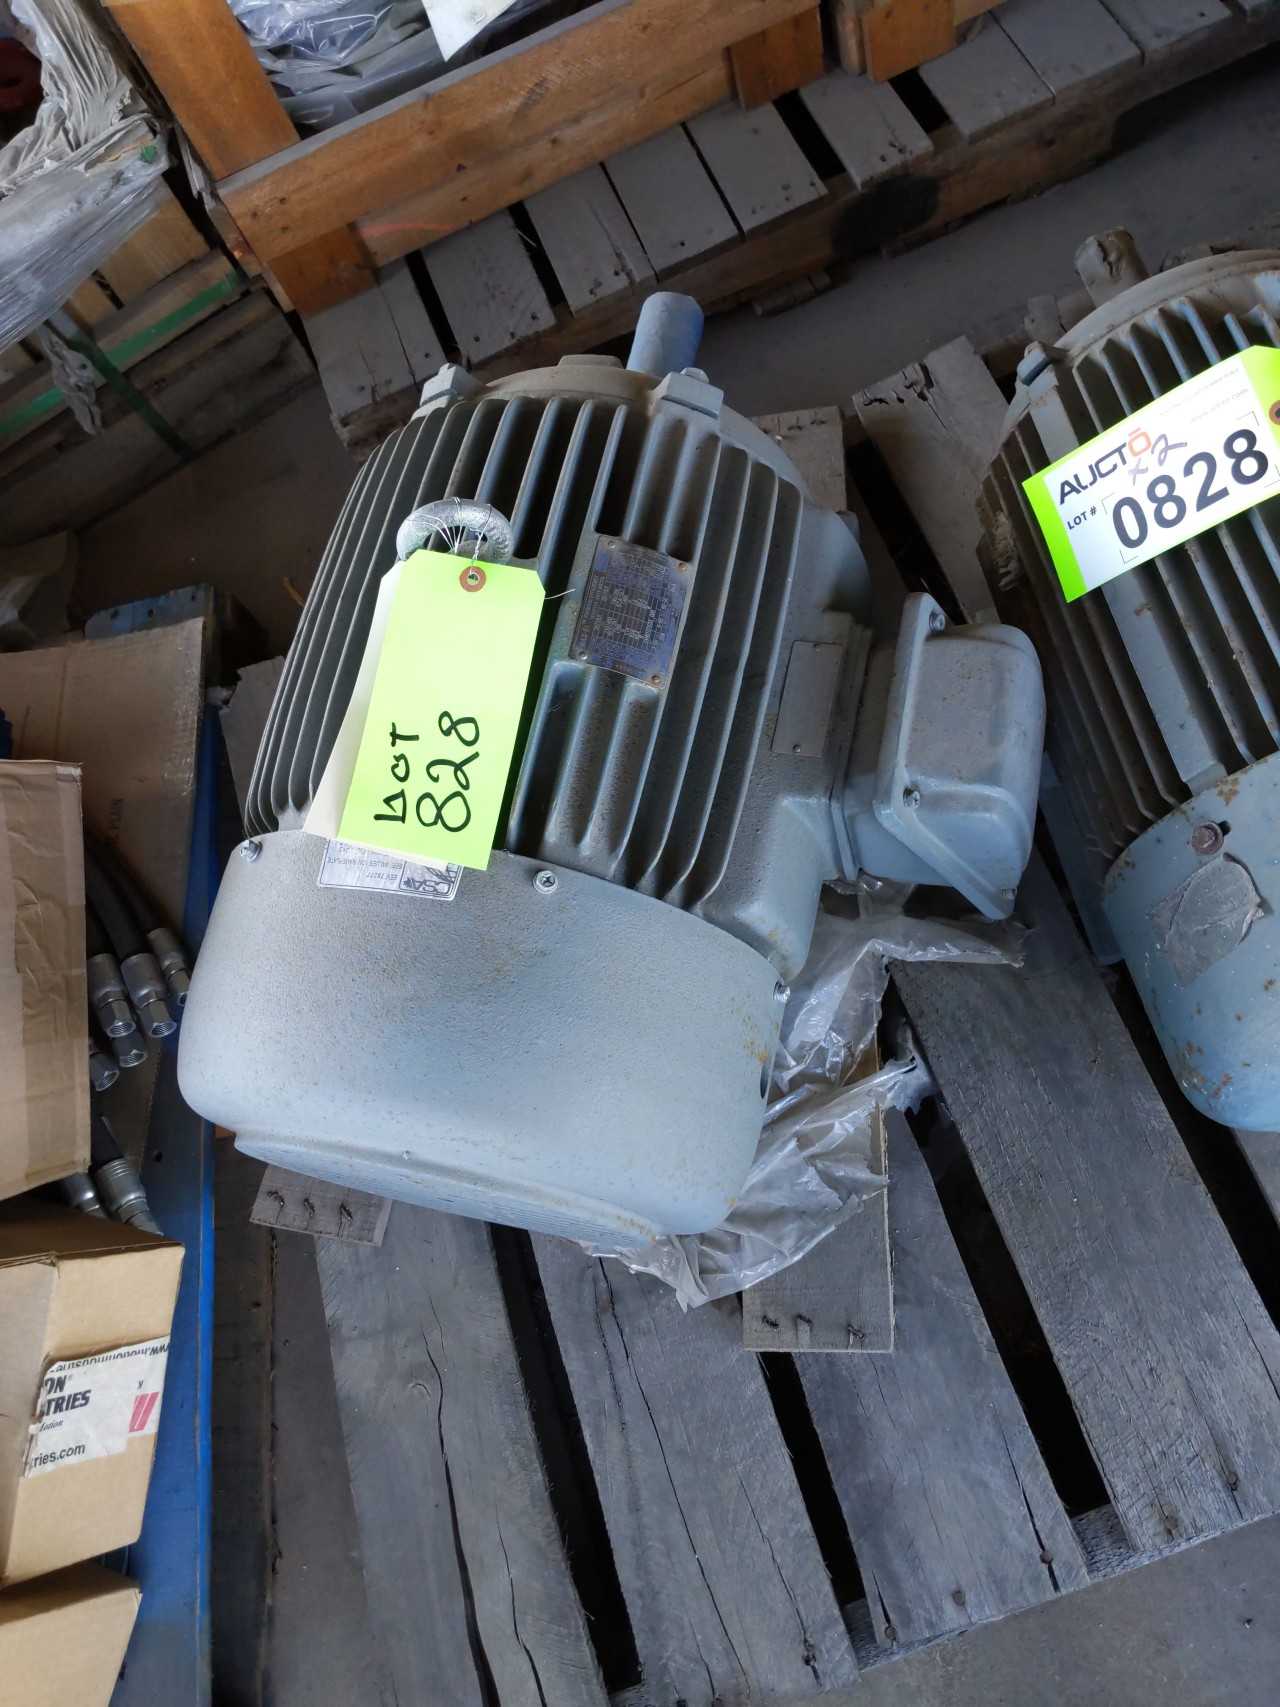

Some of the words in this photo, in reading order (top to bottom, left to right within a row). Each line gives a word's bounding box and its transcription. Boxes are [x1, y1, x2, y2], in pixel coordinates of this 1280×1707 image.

[1066, 512, 1088, 531] LOT
[1112, 428, 1269, 549] 0828
[416, 710, 480, 832] 828
[31, 1444, 86, 1468] ries.com
